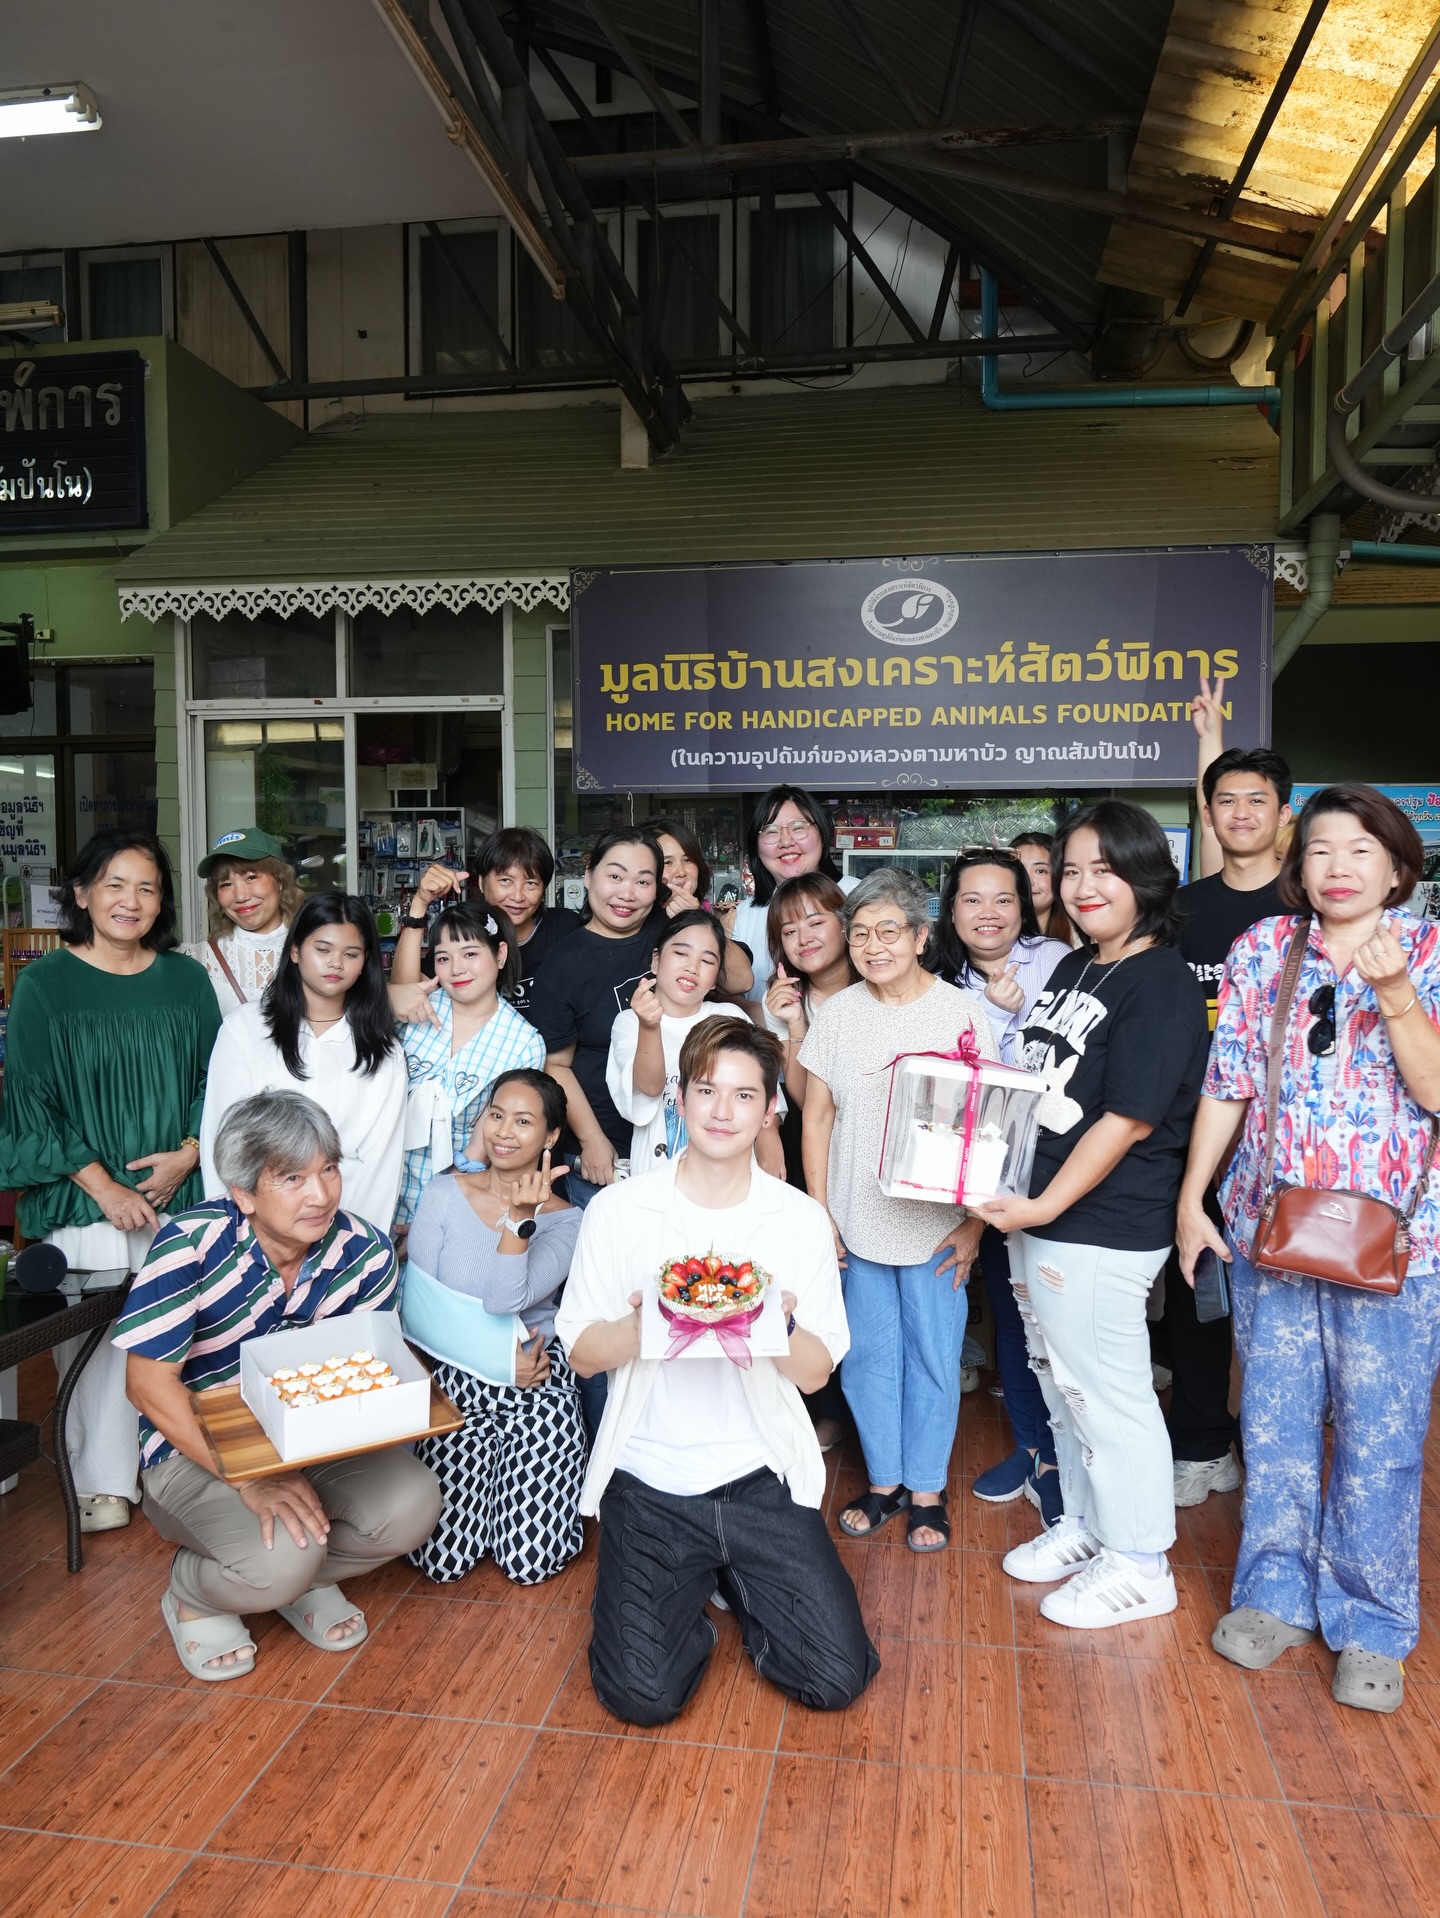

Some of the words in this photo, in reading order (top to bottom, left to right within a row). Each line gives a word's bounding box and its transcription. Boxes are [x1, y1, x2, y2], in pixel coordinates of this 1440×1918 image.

[0, 458, 93, 505] มปันโน)
[600, 638, 1239, 704] มูลนิธิบ้านสงเคราะห์สัตว์พิการ
[606, 712, 675, 731] HOME
[684, 711, 732, 730] FOR
[742, 706, 921, 729] HANDICAPPED
[930, 704, 1048, 726] ANIMALS
[1057, 701, 1233, 724] FOUNDATIN
[671, 742, 1008, 770] (ในความอุปถัมภ์ของหลวงตามหาบัว
[1015, 741, 1161, 764] ญาณสัมปันโน)
